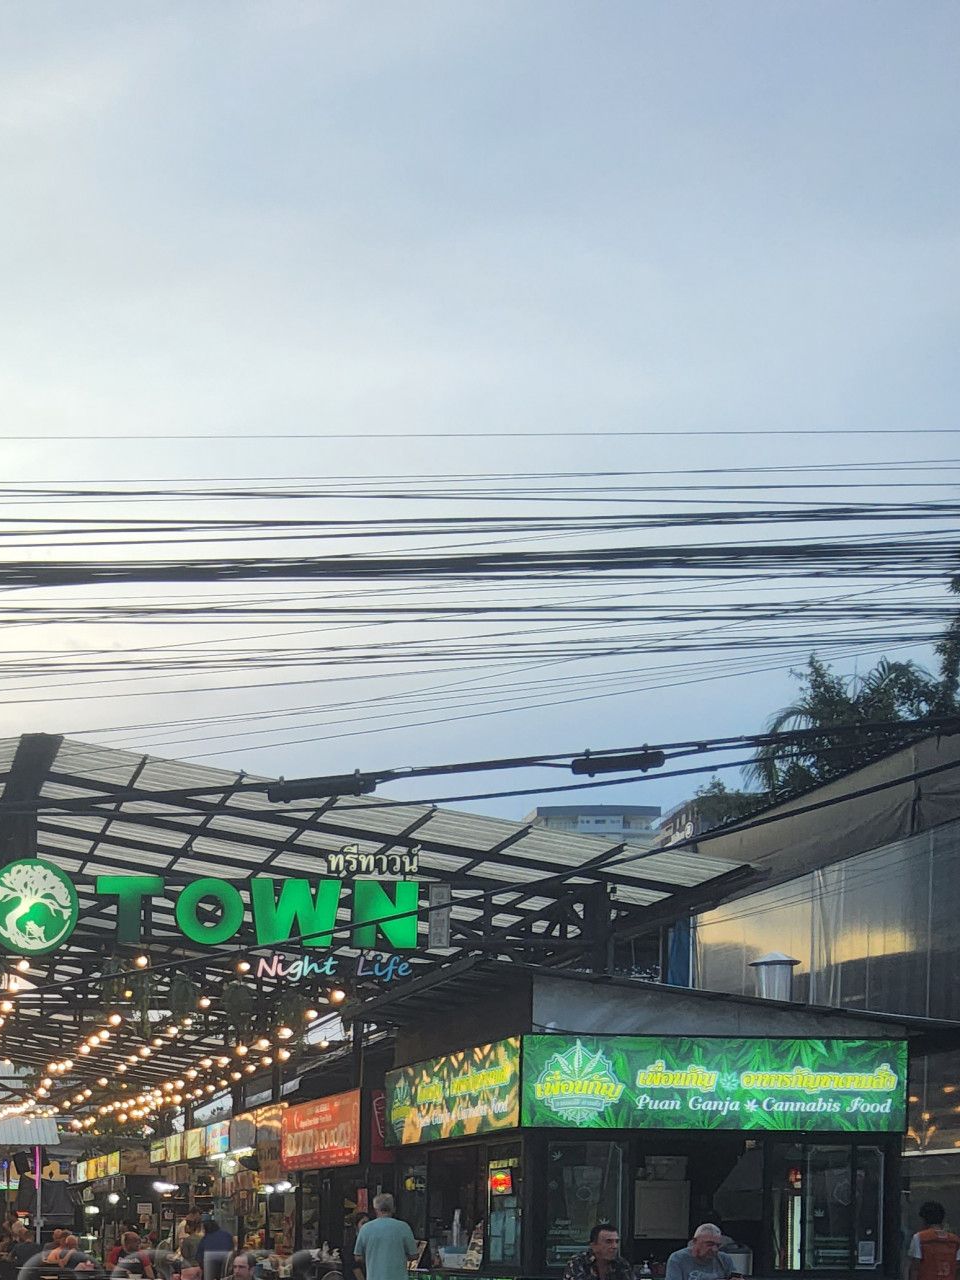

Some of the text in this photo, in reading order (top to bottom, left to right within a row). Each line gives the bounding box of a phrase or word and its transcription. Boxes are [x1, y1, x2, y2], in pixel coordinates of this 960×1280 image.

[328, 844, 422, 873] ทรีทาวน์
[96, 875, 420, 949] TOWN
[257, 954, 413, 982] Night Life
[636, 1094, 893, 1115] Puan Ganja Cannabis Food
